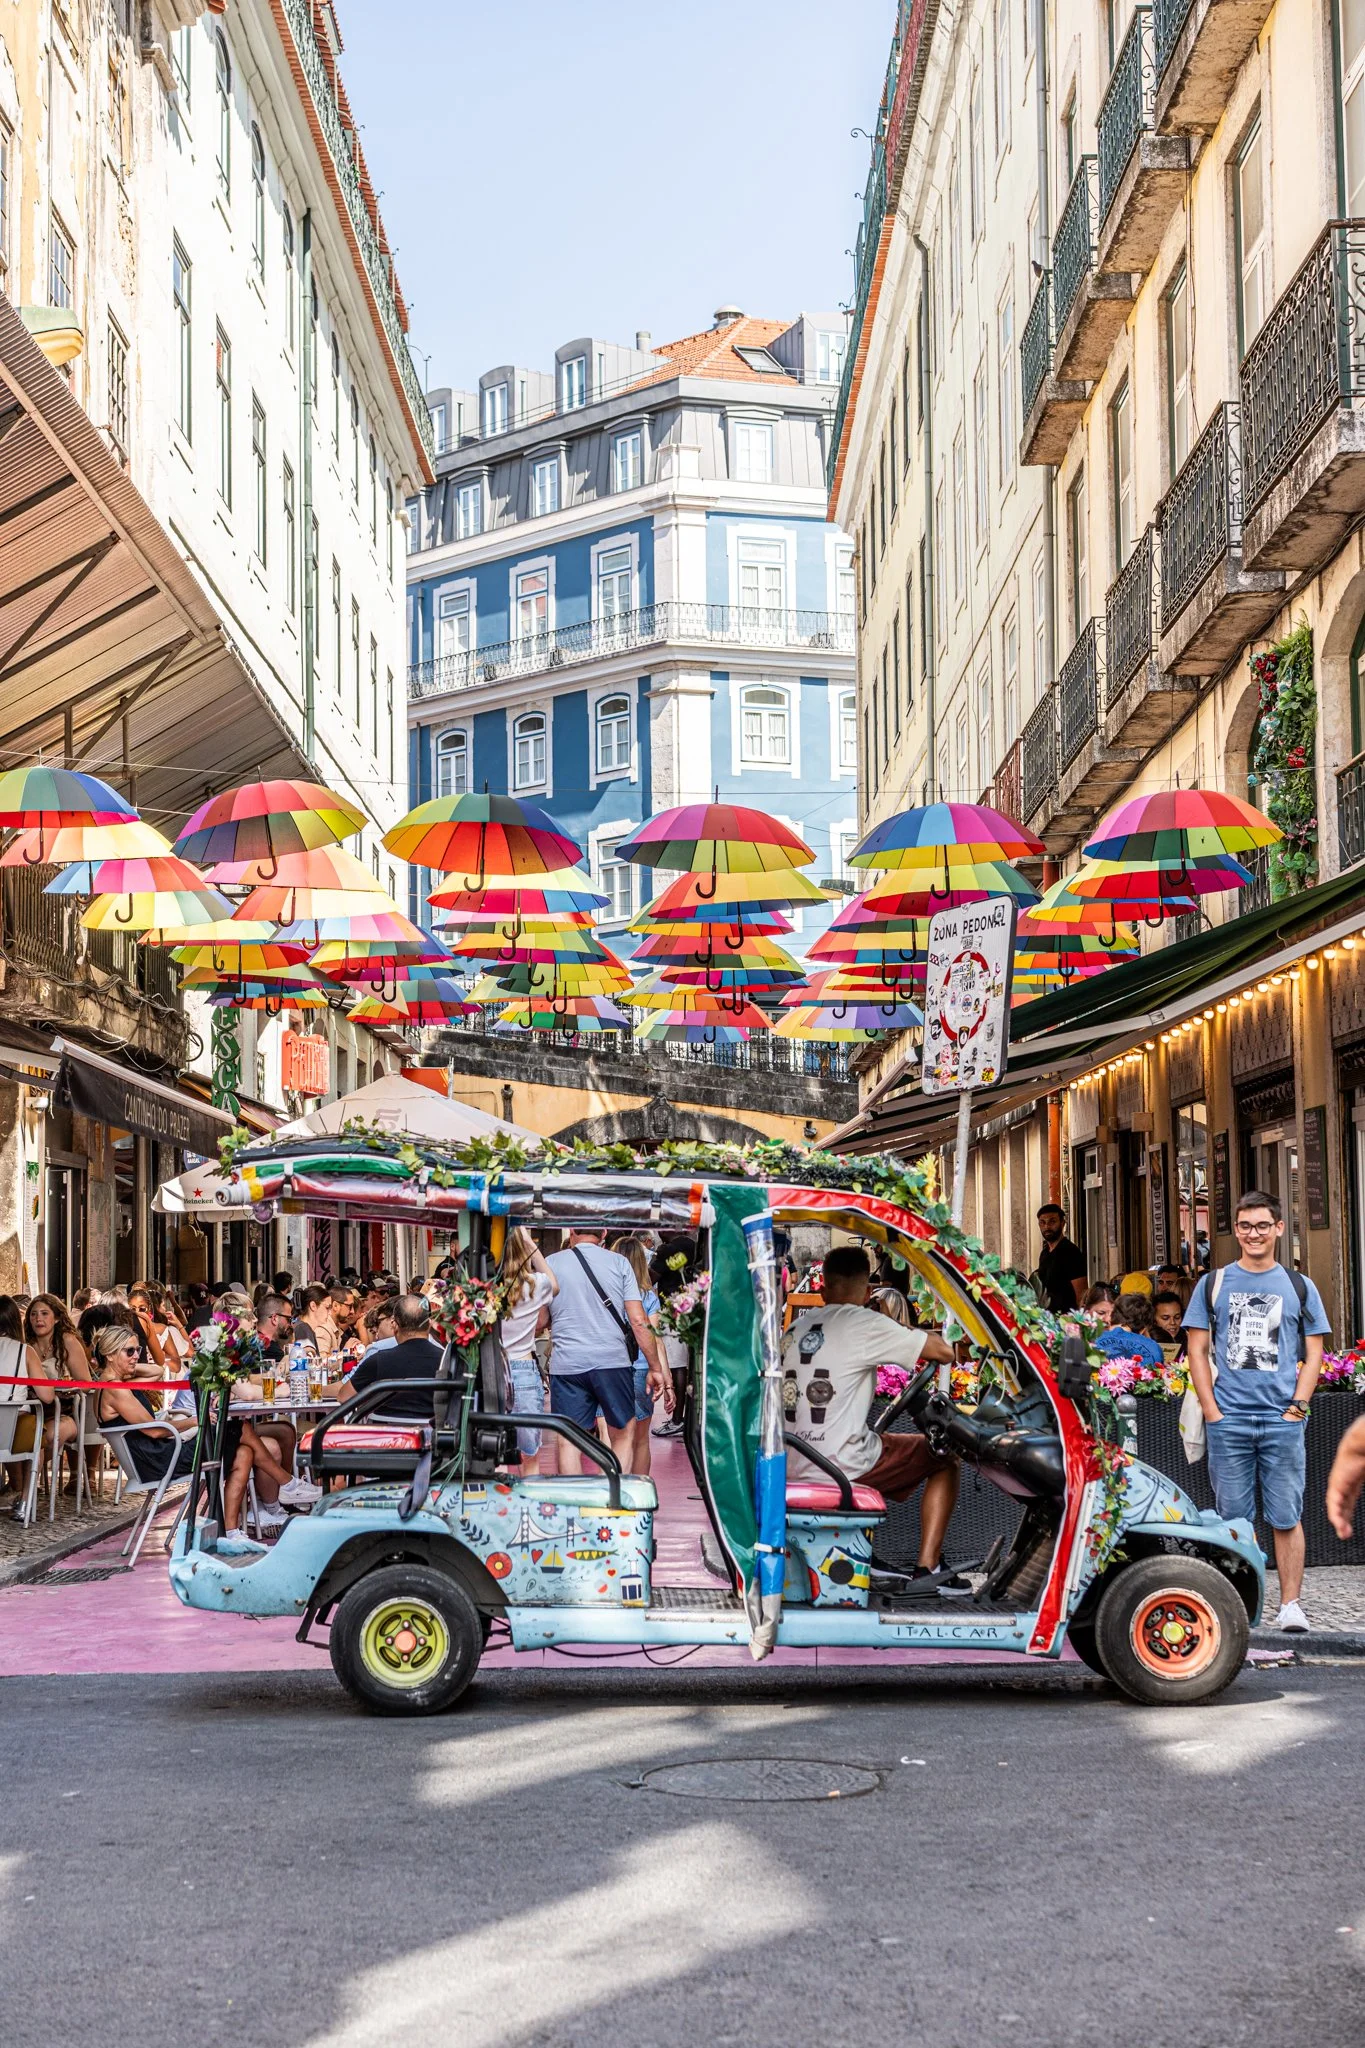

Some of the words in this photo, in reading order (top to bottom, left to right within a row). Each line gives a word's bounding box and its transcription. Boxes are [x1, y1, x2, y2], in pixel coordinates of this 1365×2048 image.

[934, 923, 958, 942] ZONA
[124, 1092, 157, 1132] CANTINHO
[158, 1106, 169, 1135] DO
[170, 1110, 191, 1144] PRAZER
[1245, 1321, 1264, 1329] TIFFOSI
[897, 1626, 999, 1638] ITALCAR
